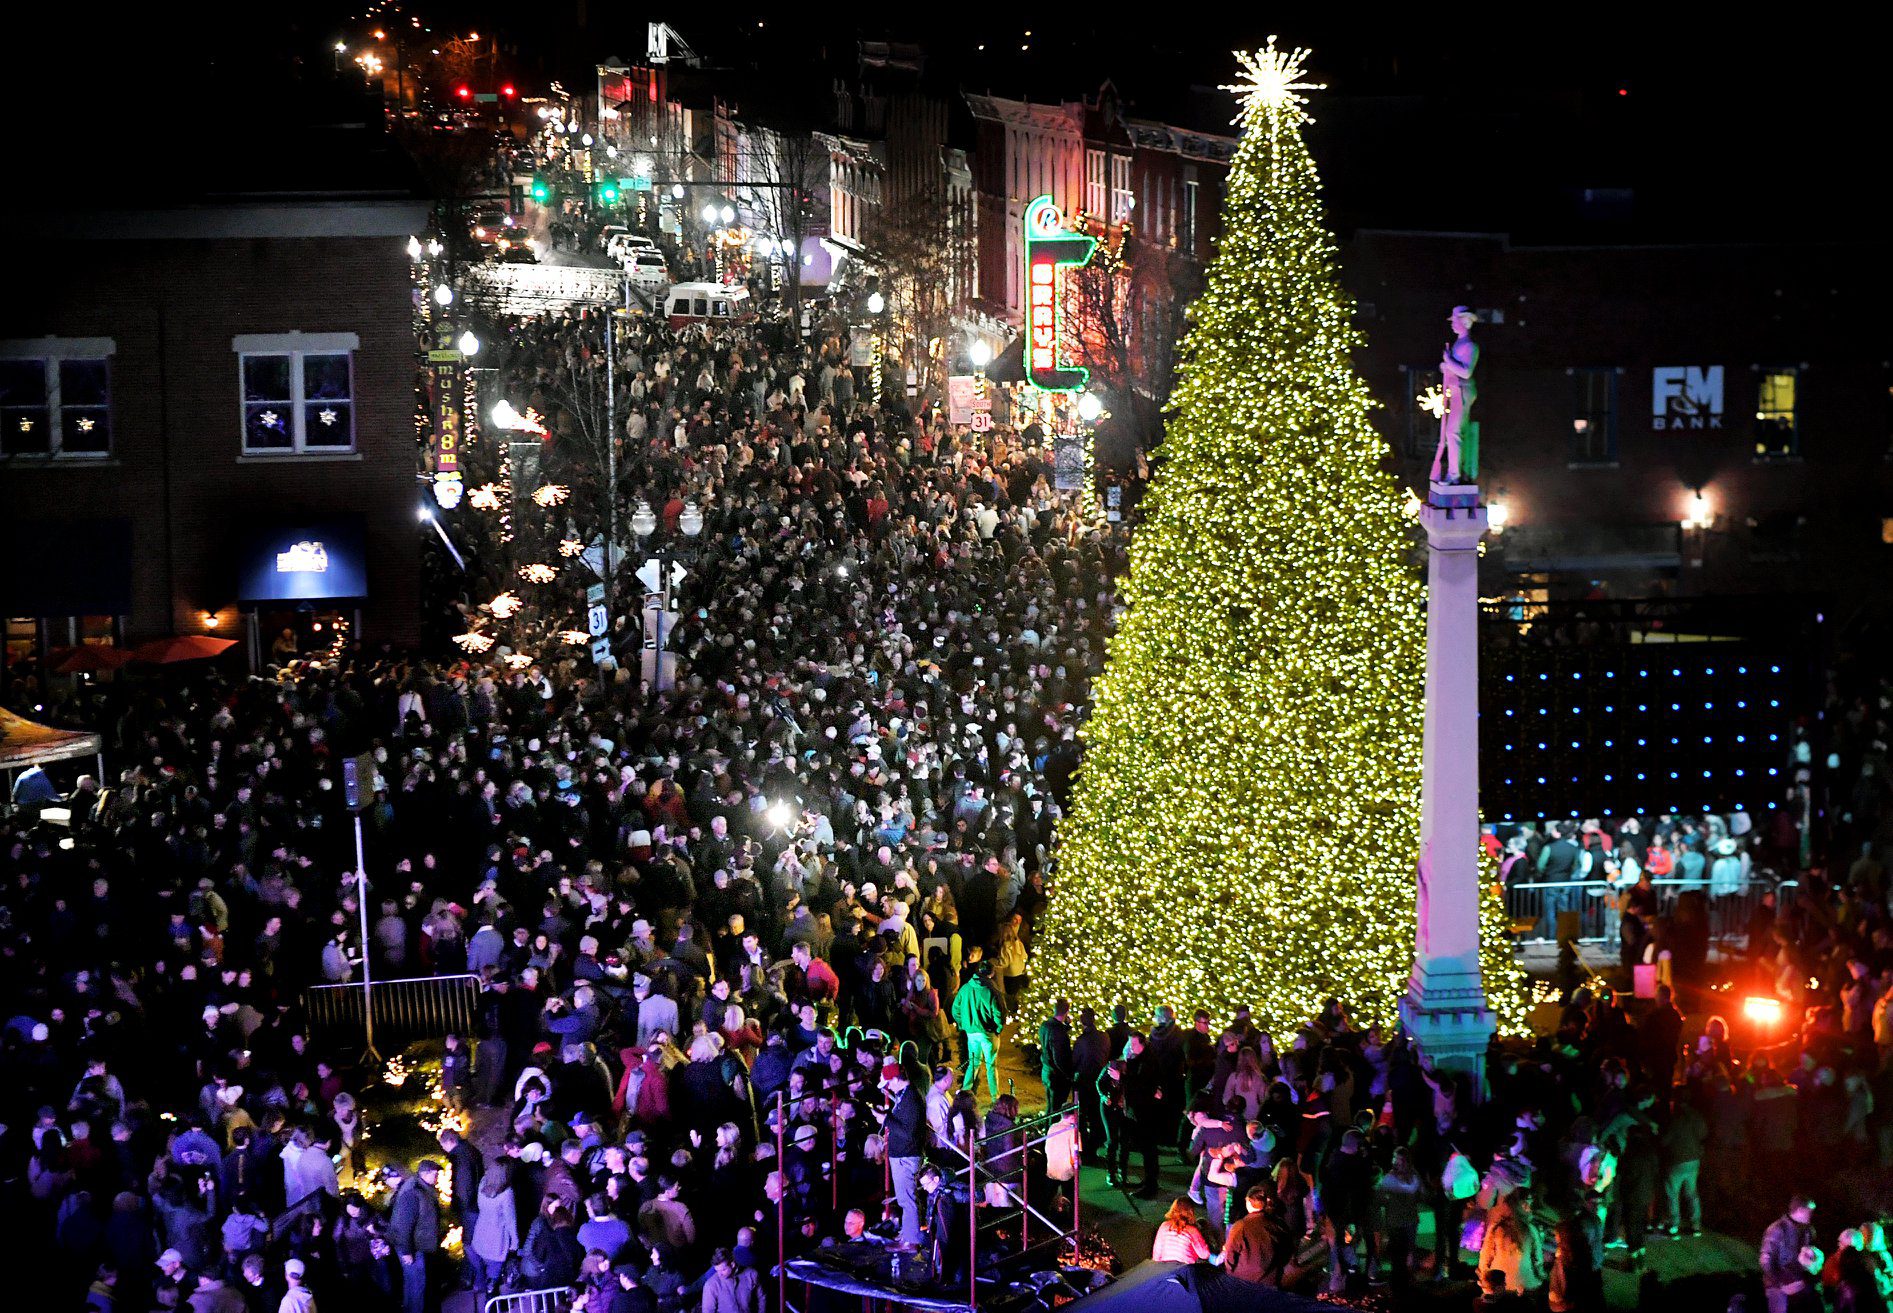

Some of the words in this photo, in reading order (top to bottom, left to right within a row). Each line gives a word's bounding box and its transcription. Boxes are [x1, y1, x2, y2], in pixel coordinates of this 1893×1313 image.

[1653, 364, 1724, 416] F&M
[971, 401, 992, 409] SOUTH
[975, 416, 987, 428] 31
[1653, 416, 1722, 430] BANK
[592, 611, 604, 631] 31
